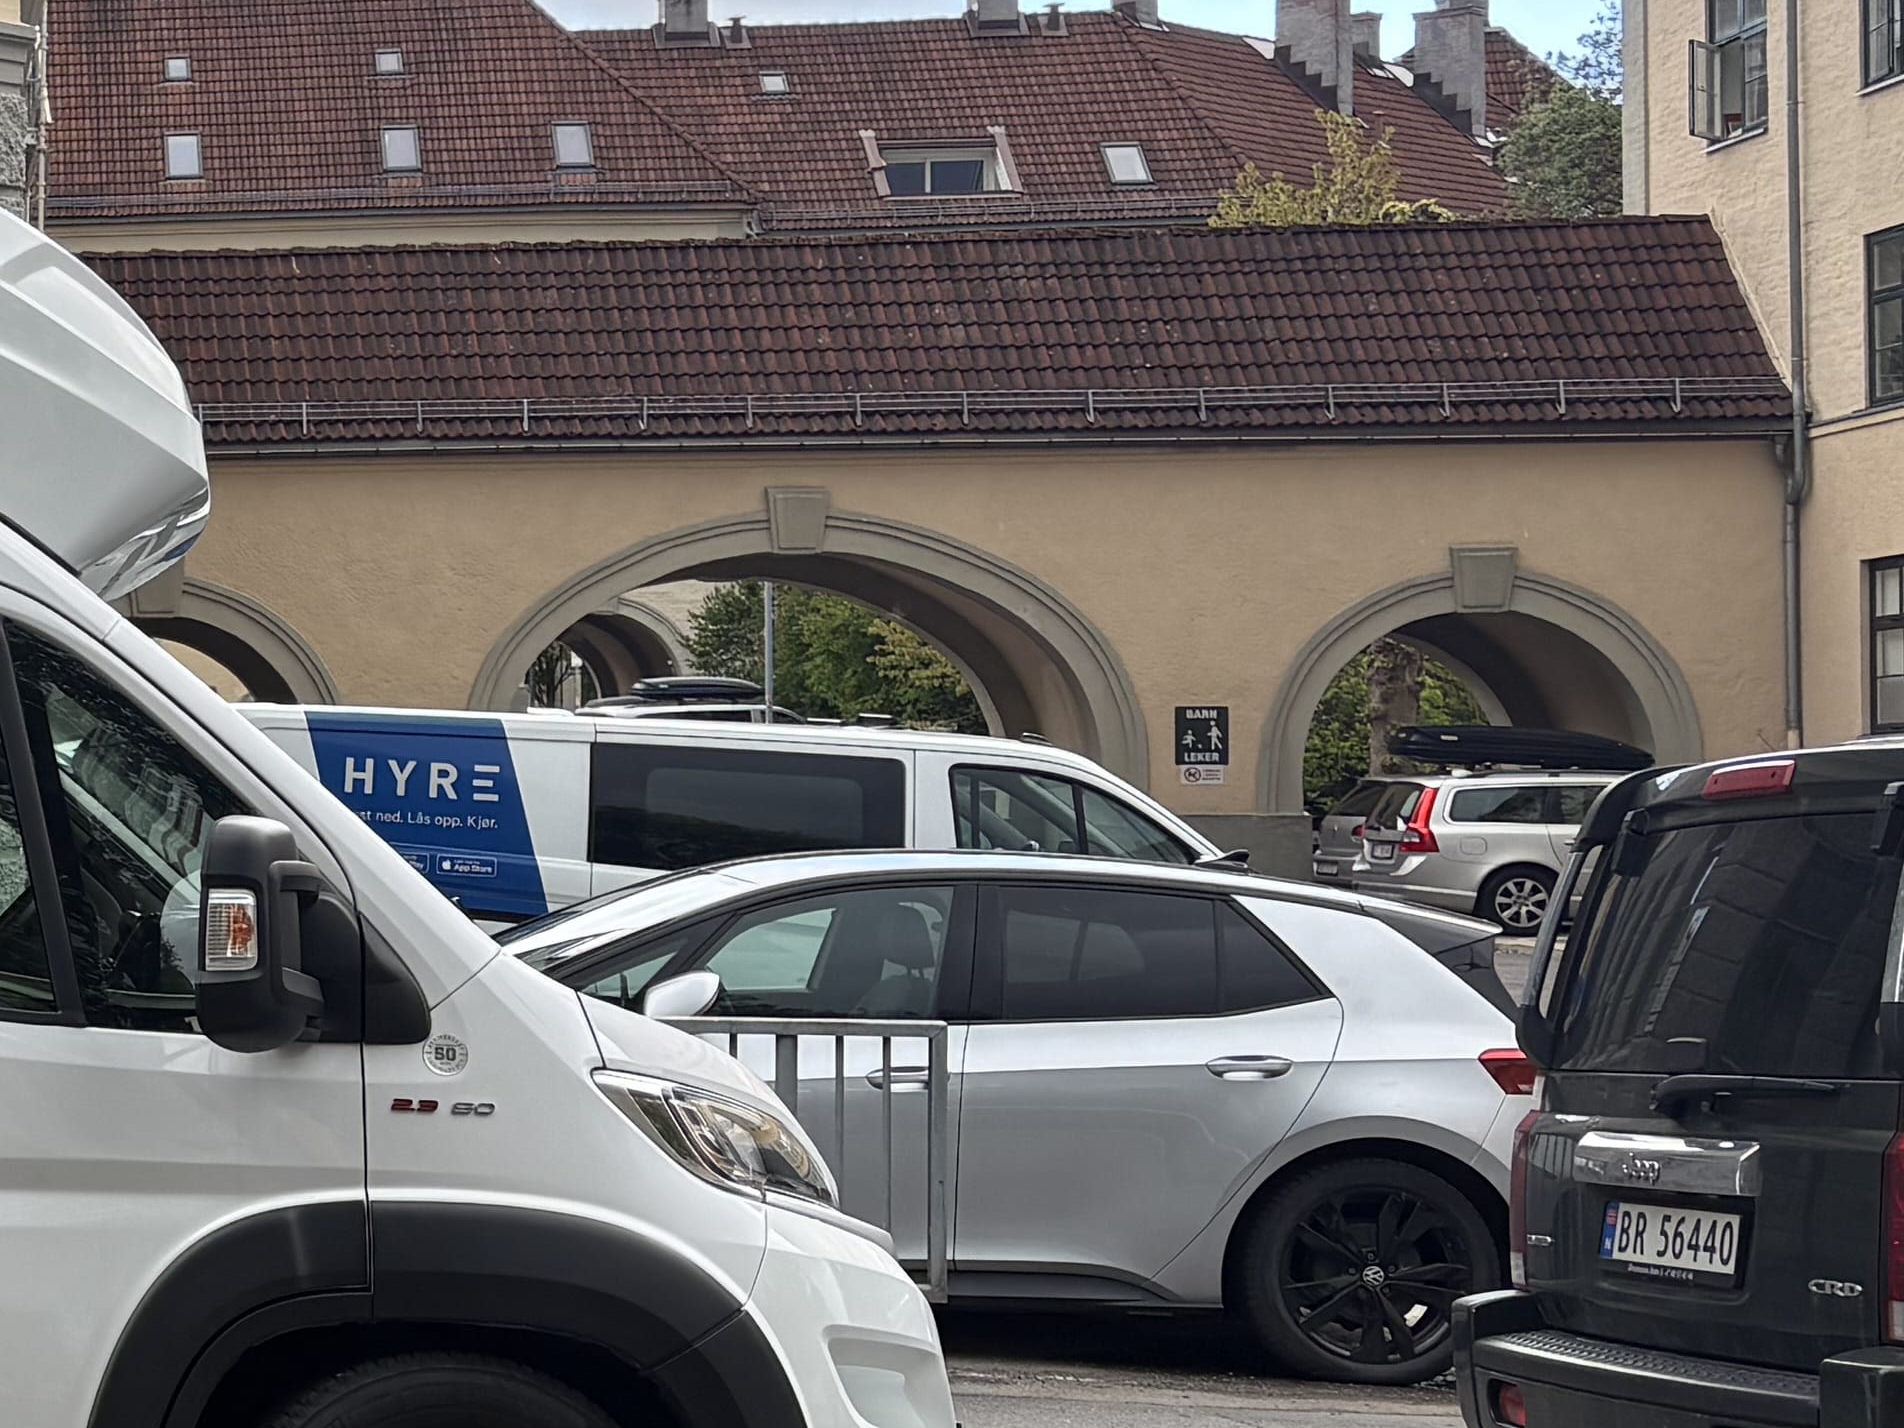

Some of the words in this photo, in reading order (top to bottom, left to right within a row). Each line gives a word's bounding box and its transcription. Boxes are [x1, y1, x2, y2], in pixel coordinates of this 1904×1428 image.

[1185, 708, 1218, 719] BARN
[1184, 752, 1220, 762] LEKER
[344, 757, 501, 802] HYRE
[375, 810, 404, 823] ned.
[407, 811, 431, 825] Lås
[434, 815, 463, 829] opp.
[467, 815, 498, 830] Kjør.
[1618, 1210, 1648, 1256] BR
[1656, 1214, 1734, 1266] 56440
[1808, 1279, 1863, 1297] CRD
